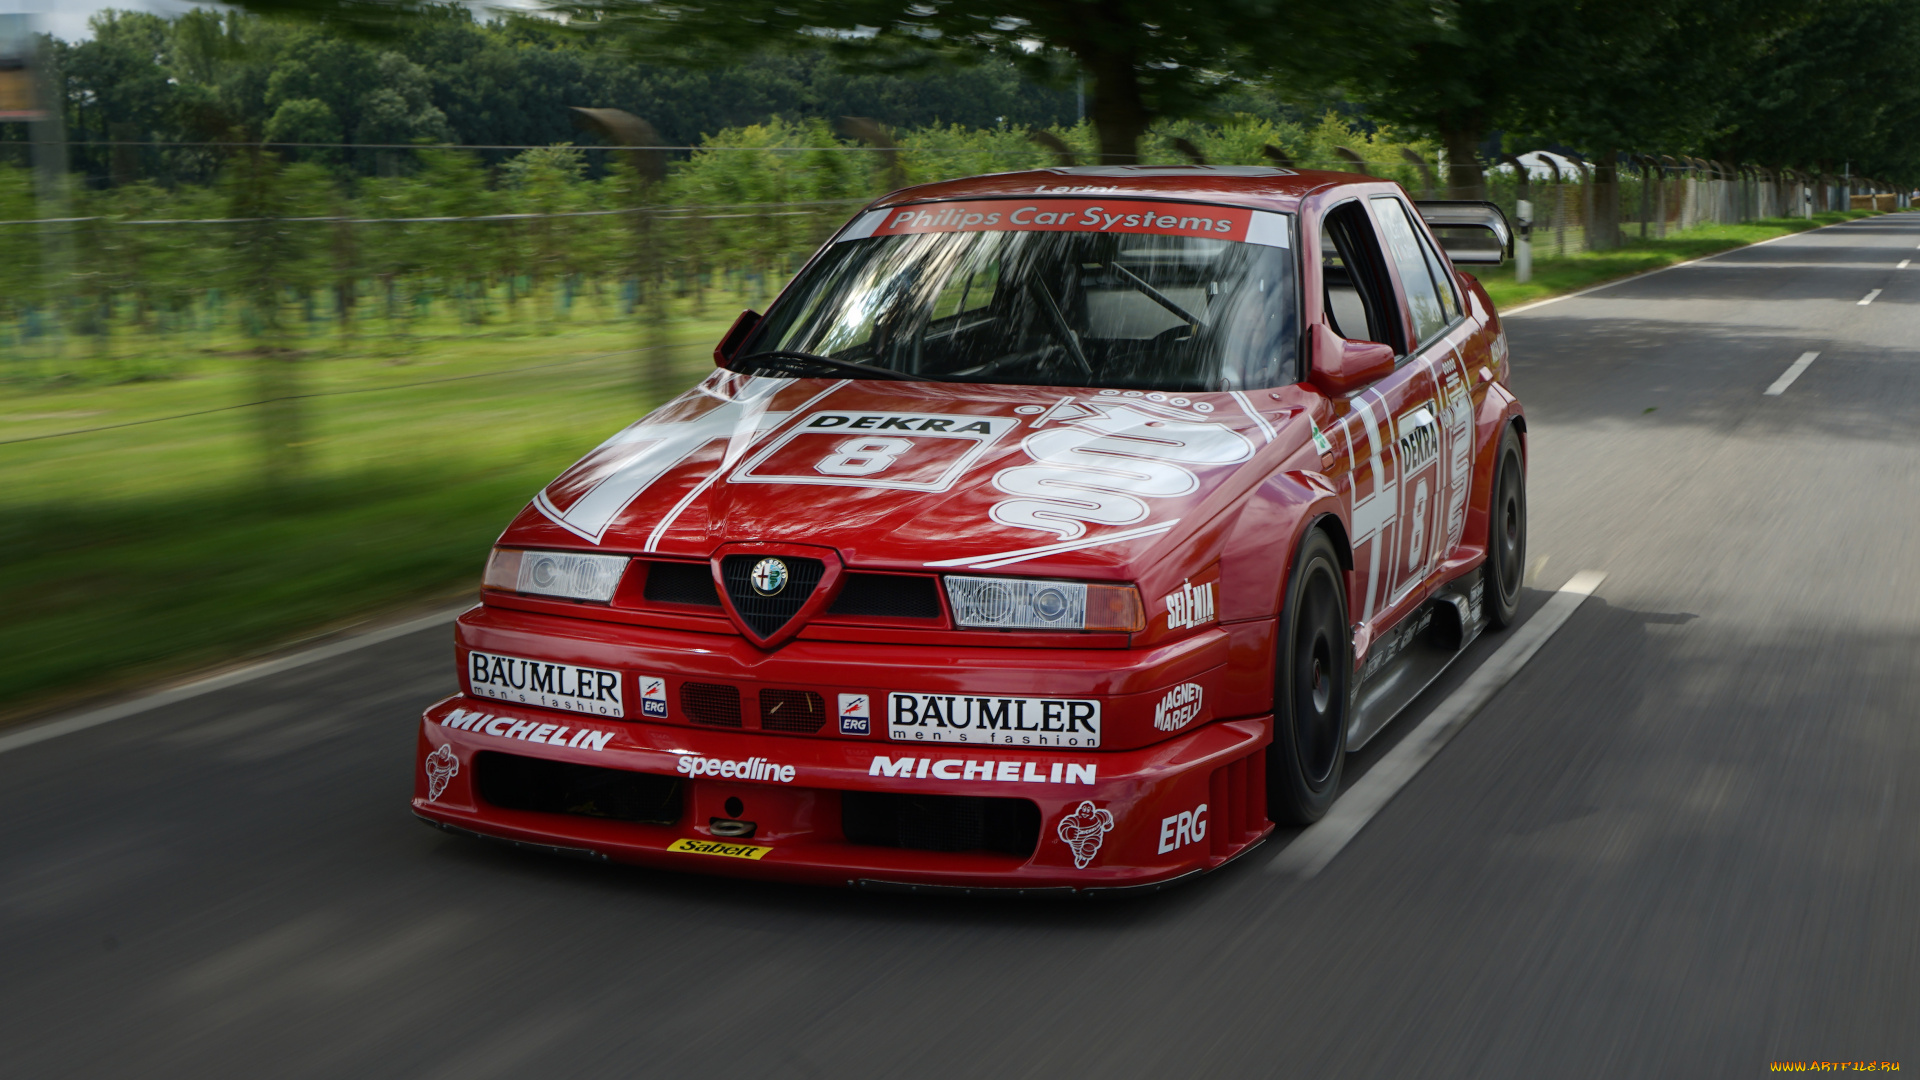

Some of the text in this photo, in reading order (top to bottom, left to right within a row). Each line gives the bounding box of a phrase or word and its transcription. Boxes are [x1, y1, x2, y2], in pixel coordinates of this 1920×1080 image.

[1034, 185, 1118, 193] Larini
[889, 206, 1232, 233] Philips Car Systems
[807, 415, 991, 435] DEKRA
[813, 437, 915, 476] 8
[1400, 421, 1438, 475] DEKRA
[1409, 476, 1429, 573] 8
[472, 653, 619, 704] BÄUMLER
[473, 686, 621, 717] men's fashion
[644, 700, 665, 713] ERG
[892, 694, 1097, 734] BÄUMLER
[440, 708, 616, 752] MICHELIN
[843, 718, 867, 730] ERG
[893, 730, 1096, 746] men's fashion
[676, 755, 796, 783] speedline
[868, 756, 1097, 785] MICHELIN
[1157, 803, 1208, 855] ERG
[679, 840, 757, 857] Sabelt
